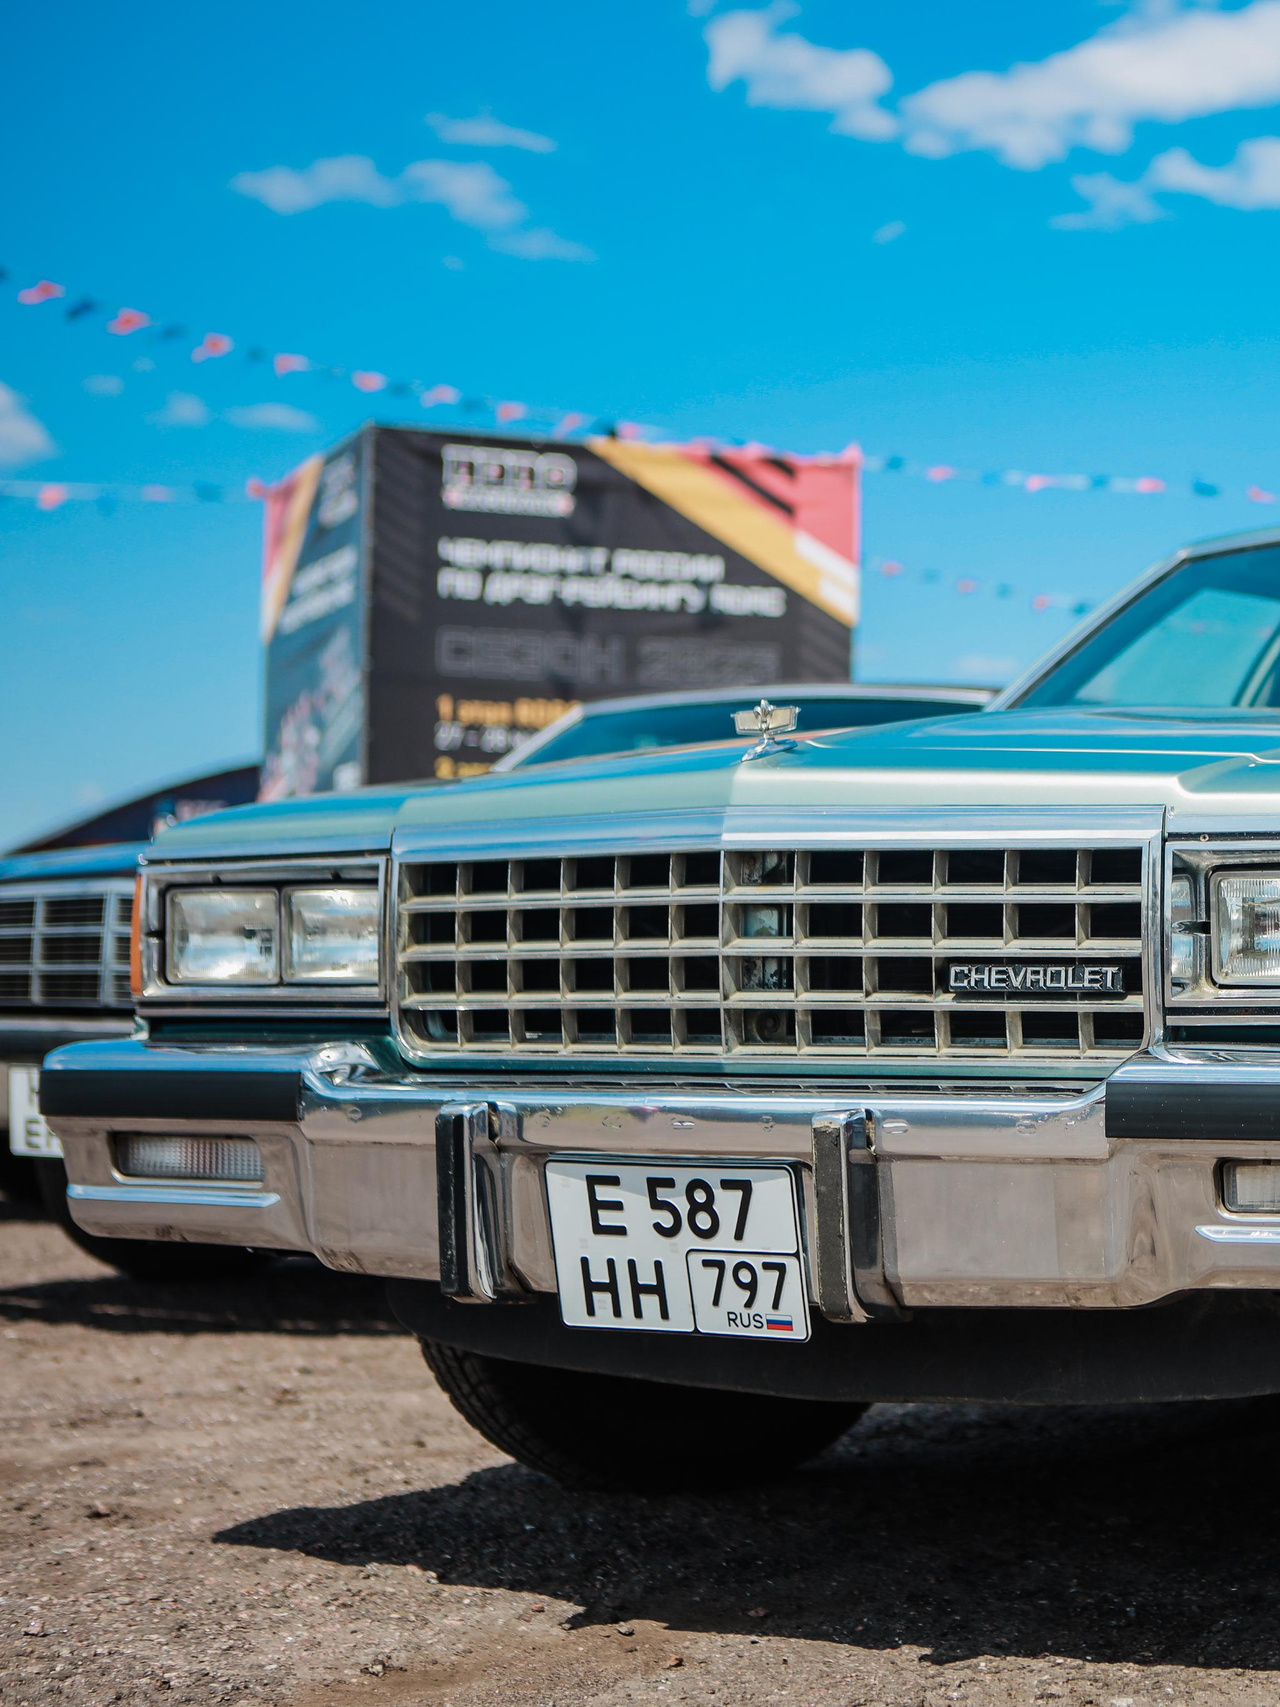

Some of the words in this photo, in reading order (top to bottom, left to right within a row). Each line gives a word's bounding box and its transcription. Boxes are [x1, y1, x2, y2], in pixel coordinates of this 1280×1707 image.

[950, 966, 1120, 991] CHEVROLET
[646, 1176, 753, 1241] 587
[701, 1258, 787, 1310] 797
[727, 1311, 764, 1329] RUS
